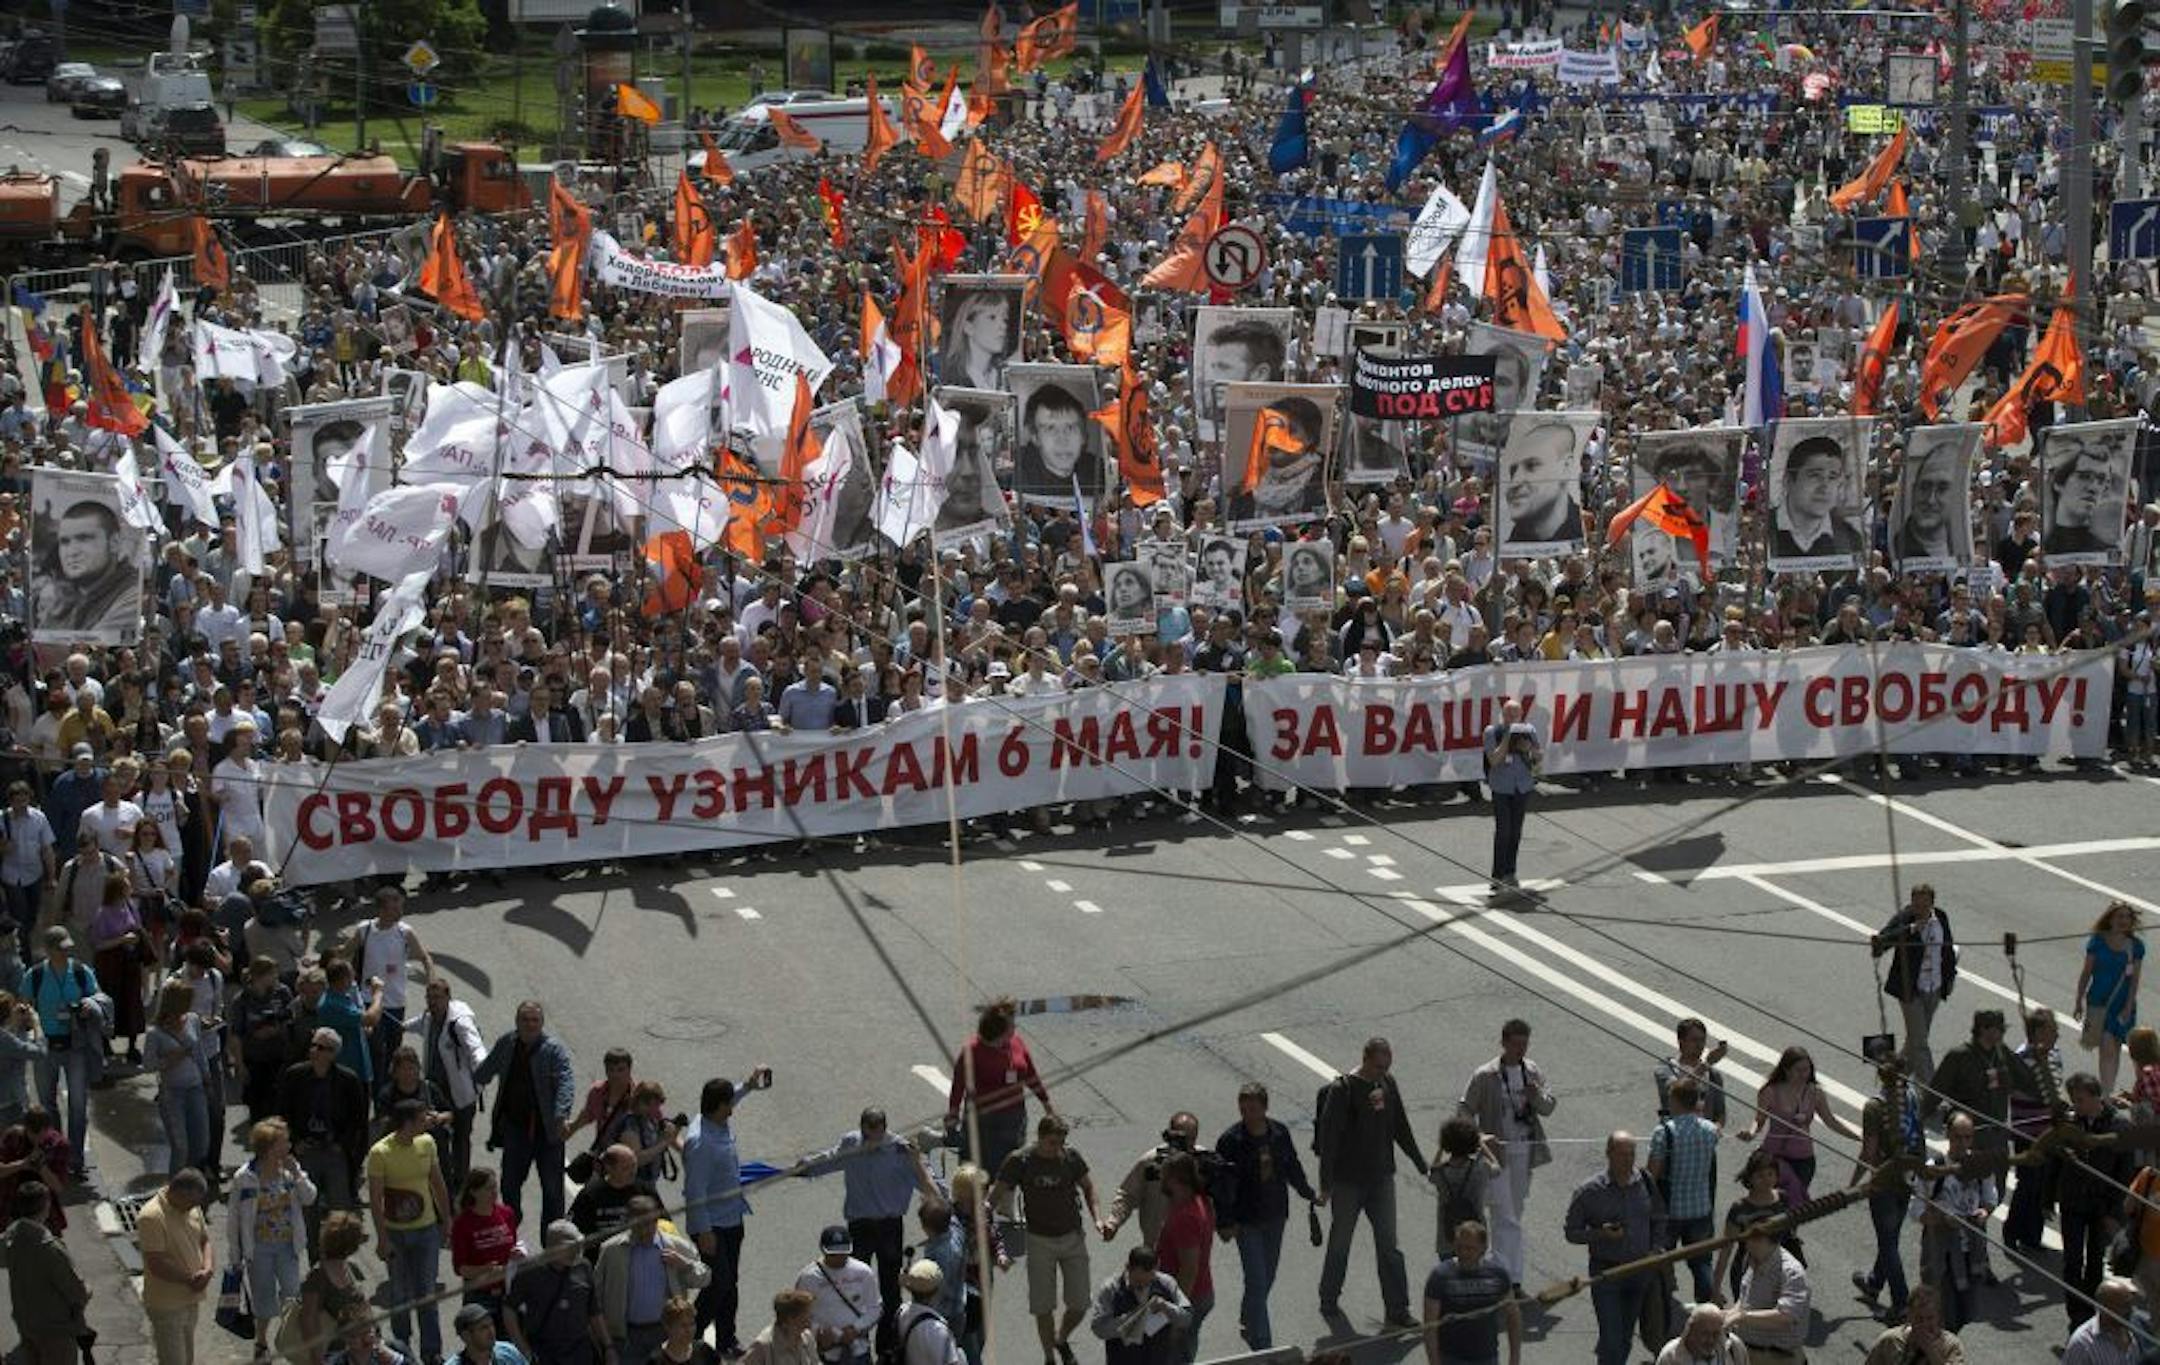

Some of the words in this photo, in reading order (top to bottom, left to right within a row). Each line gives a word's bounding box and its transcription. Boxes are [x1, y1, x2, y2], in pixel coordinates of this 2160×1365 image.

[1376, 392, 1440, 417] ПОД
[1445, 384, 1494, 411] СУД
[1270, 704, 1343, 761] ЗА
[1551, 691, 1593, 743] И
[1608, 679, 1789, 740] НАШУ
[1802, 670, 2089, 732] СВОБОДУ!
[297, 776, 626, 851] СВОБОДУ
[647, 733, 980, 824] УЗНИКАМ
[997, 726, 1030, 777] 6
[1049, 704, 1205, 770] МАЯ!
